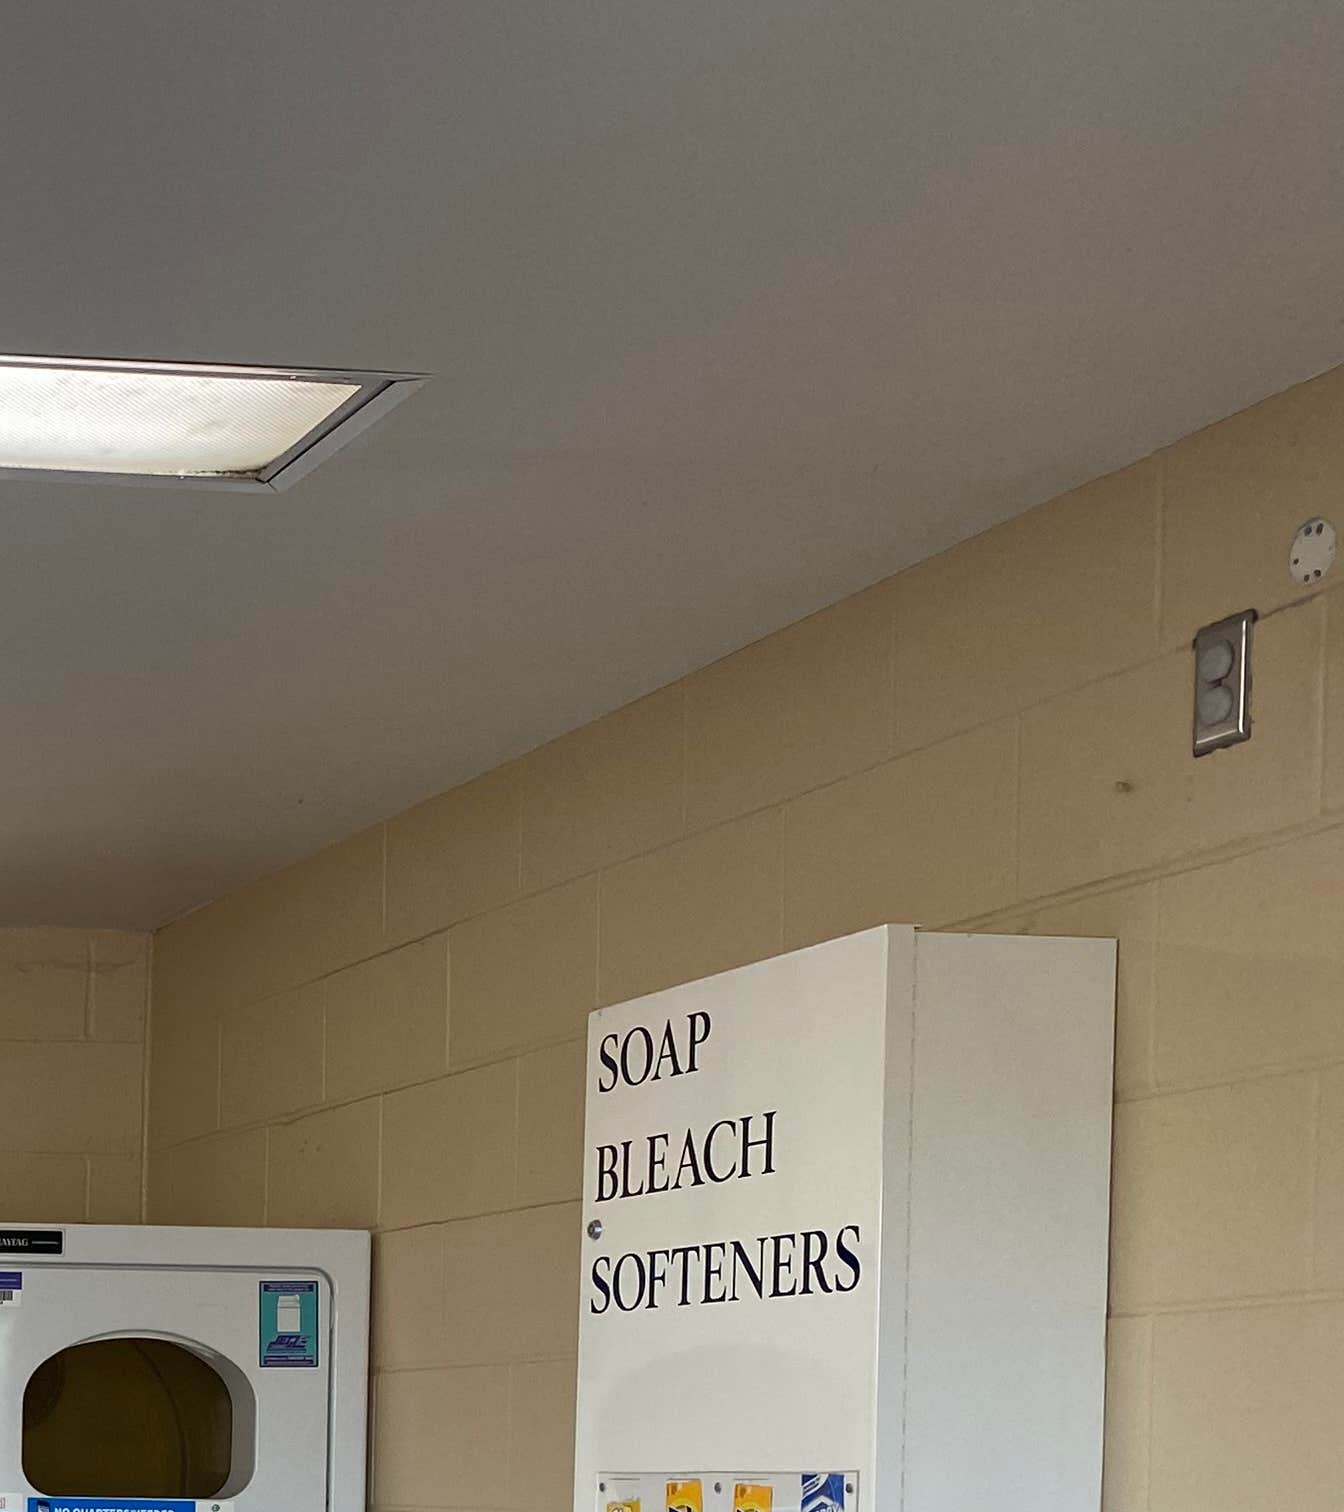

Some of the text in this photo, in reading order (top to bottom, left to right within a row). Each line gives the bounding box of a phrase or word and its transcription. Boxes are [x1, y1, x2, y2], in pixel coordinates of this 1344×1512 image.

[597, 1011, 711, 1093] SOAP
[595, 1110, 778, 1203] BLEACH
[590, 1224, 861, 1315] SOFTENERS
